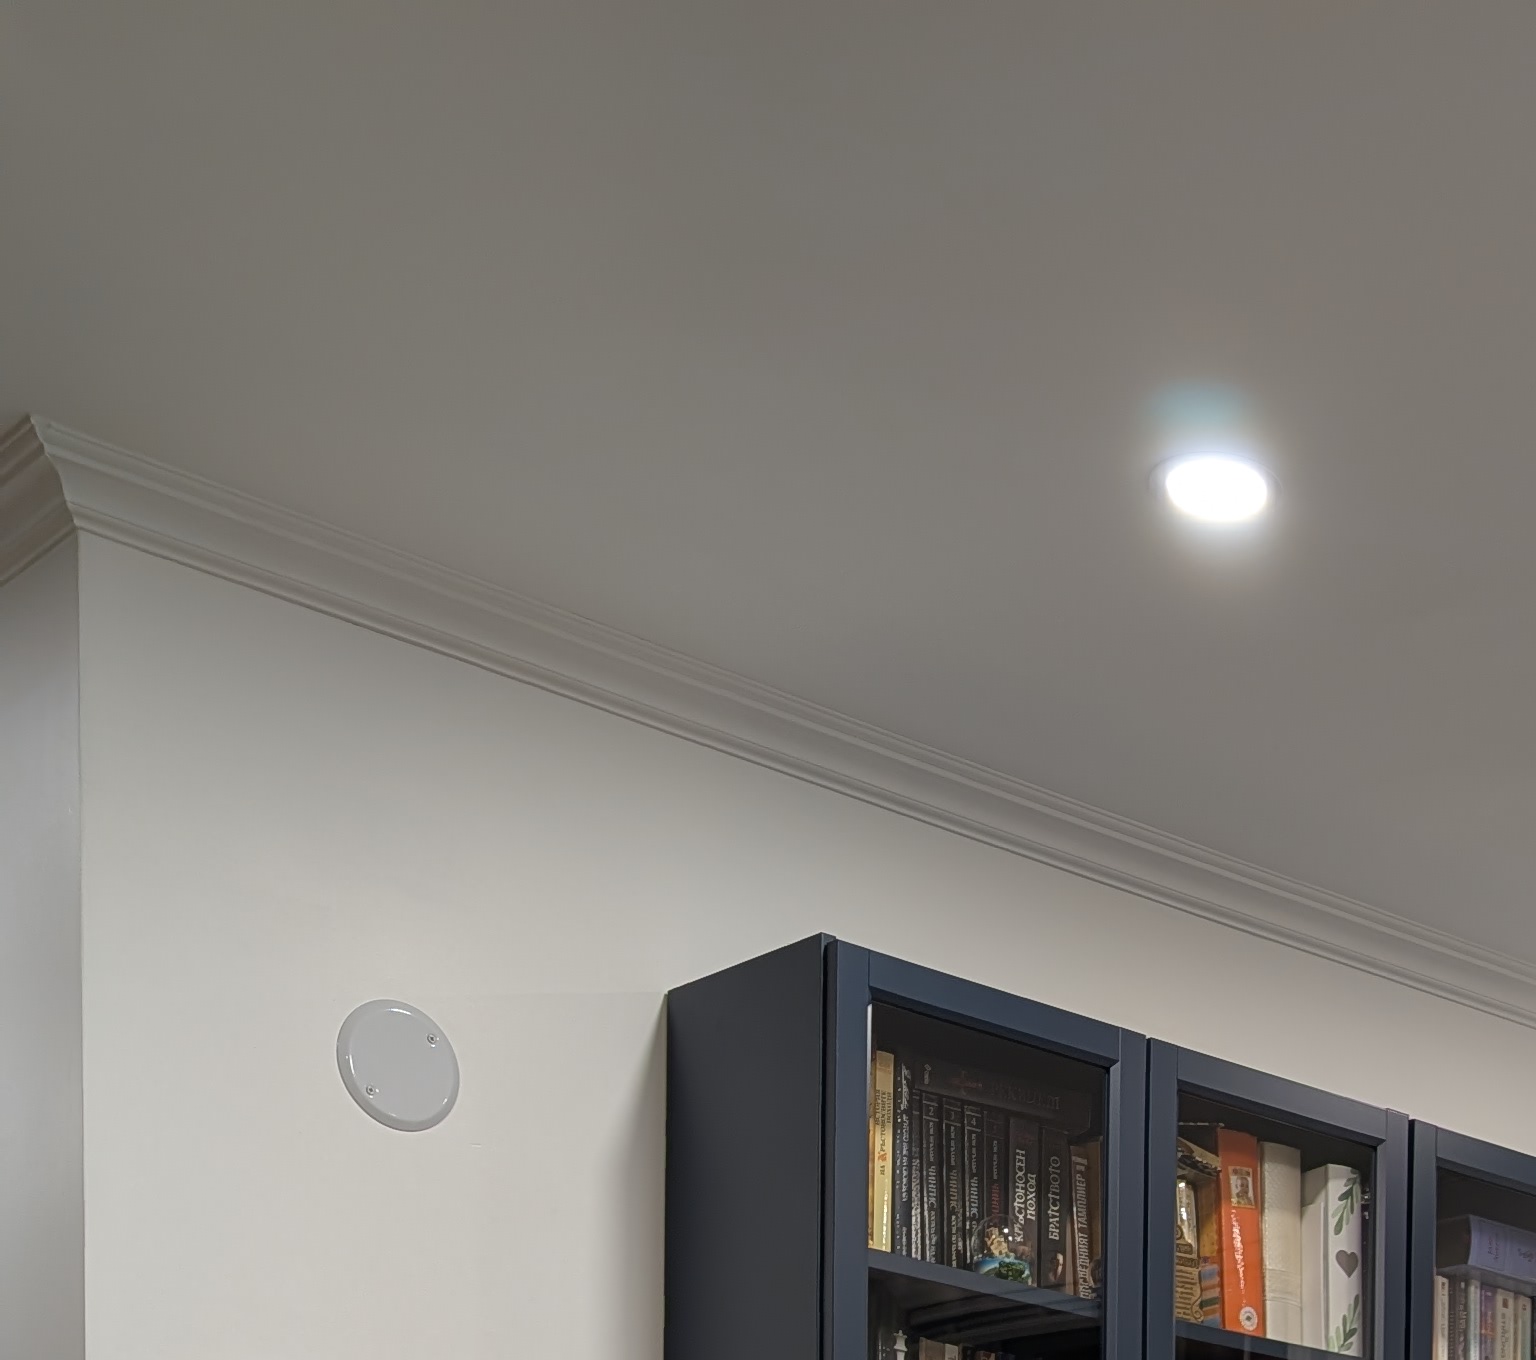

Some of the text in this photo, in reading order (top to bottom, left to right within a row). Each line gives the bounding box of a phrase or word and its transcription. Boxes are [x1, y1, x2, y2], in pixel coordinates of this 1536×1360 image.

[928, 1166, 938, 1209] ЧИНГИС
[970, 1177, 979, 1219] ЧИНГИС
[1013, 1148, 1027, 1244] КРЪСТОНОСЕН
[1026, 1173, 1038, 1221] ПОХОД
[1047, 1156, 1061, 1240] БРАТСТВОТО
[1077, 1173, 1088, 1229] ТАМПЛИЕР
